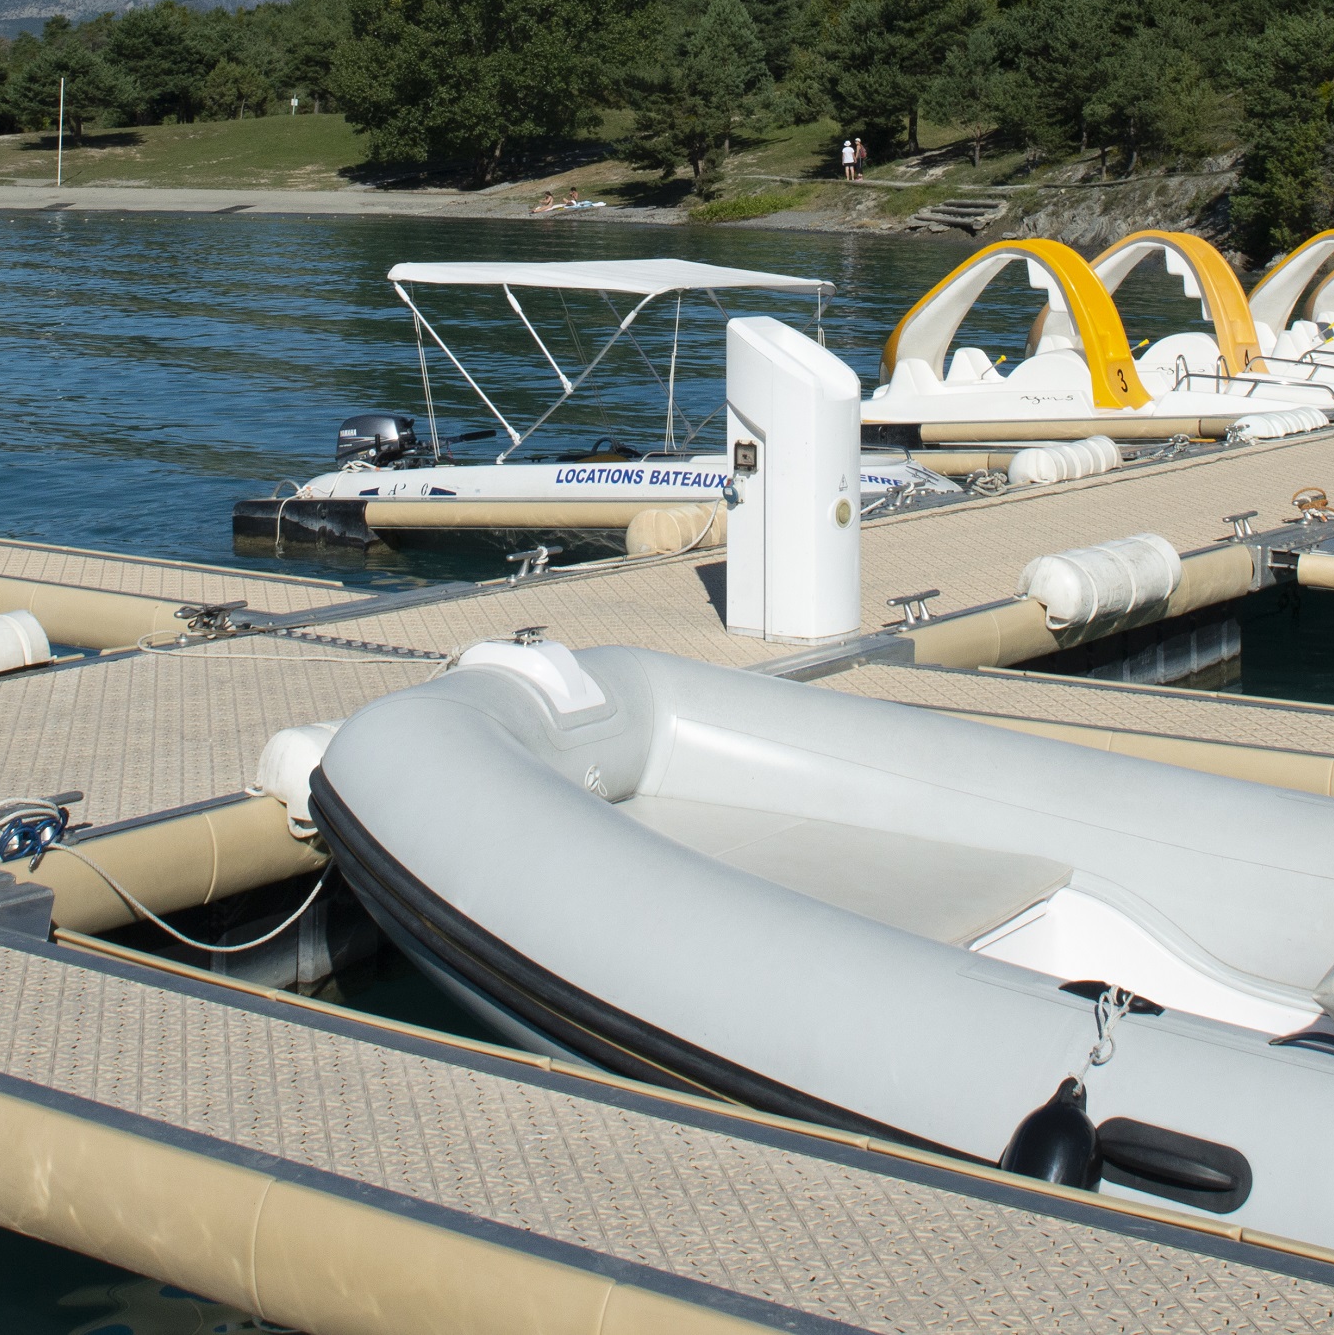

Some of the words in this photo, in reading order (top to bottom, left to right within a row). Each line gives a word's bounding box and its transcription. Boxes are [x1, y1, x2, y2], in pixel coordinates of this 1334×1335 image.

[1117, 368, 1128, 393] 3
[556, 469, 644, 484] LOCATIONS
[649, 470, 727, 488] BATEAUX
